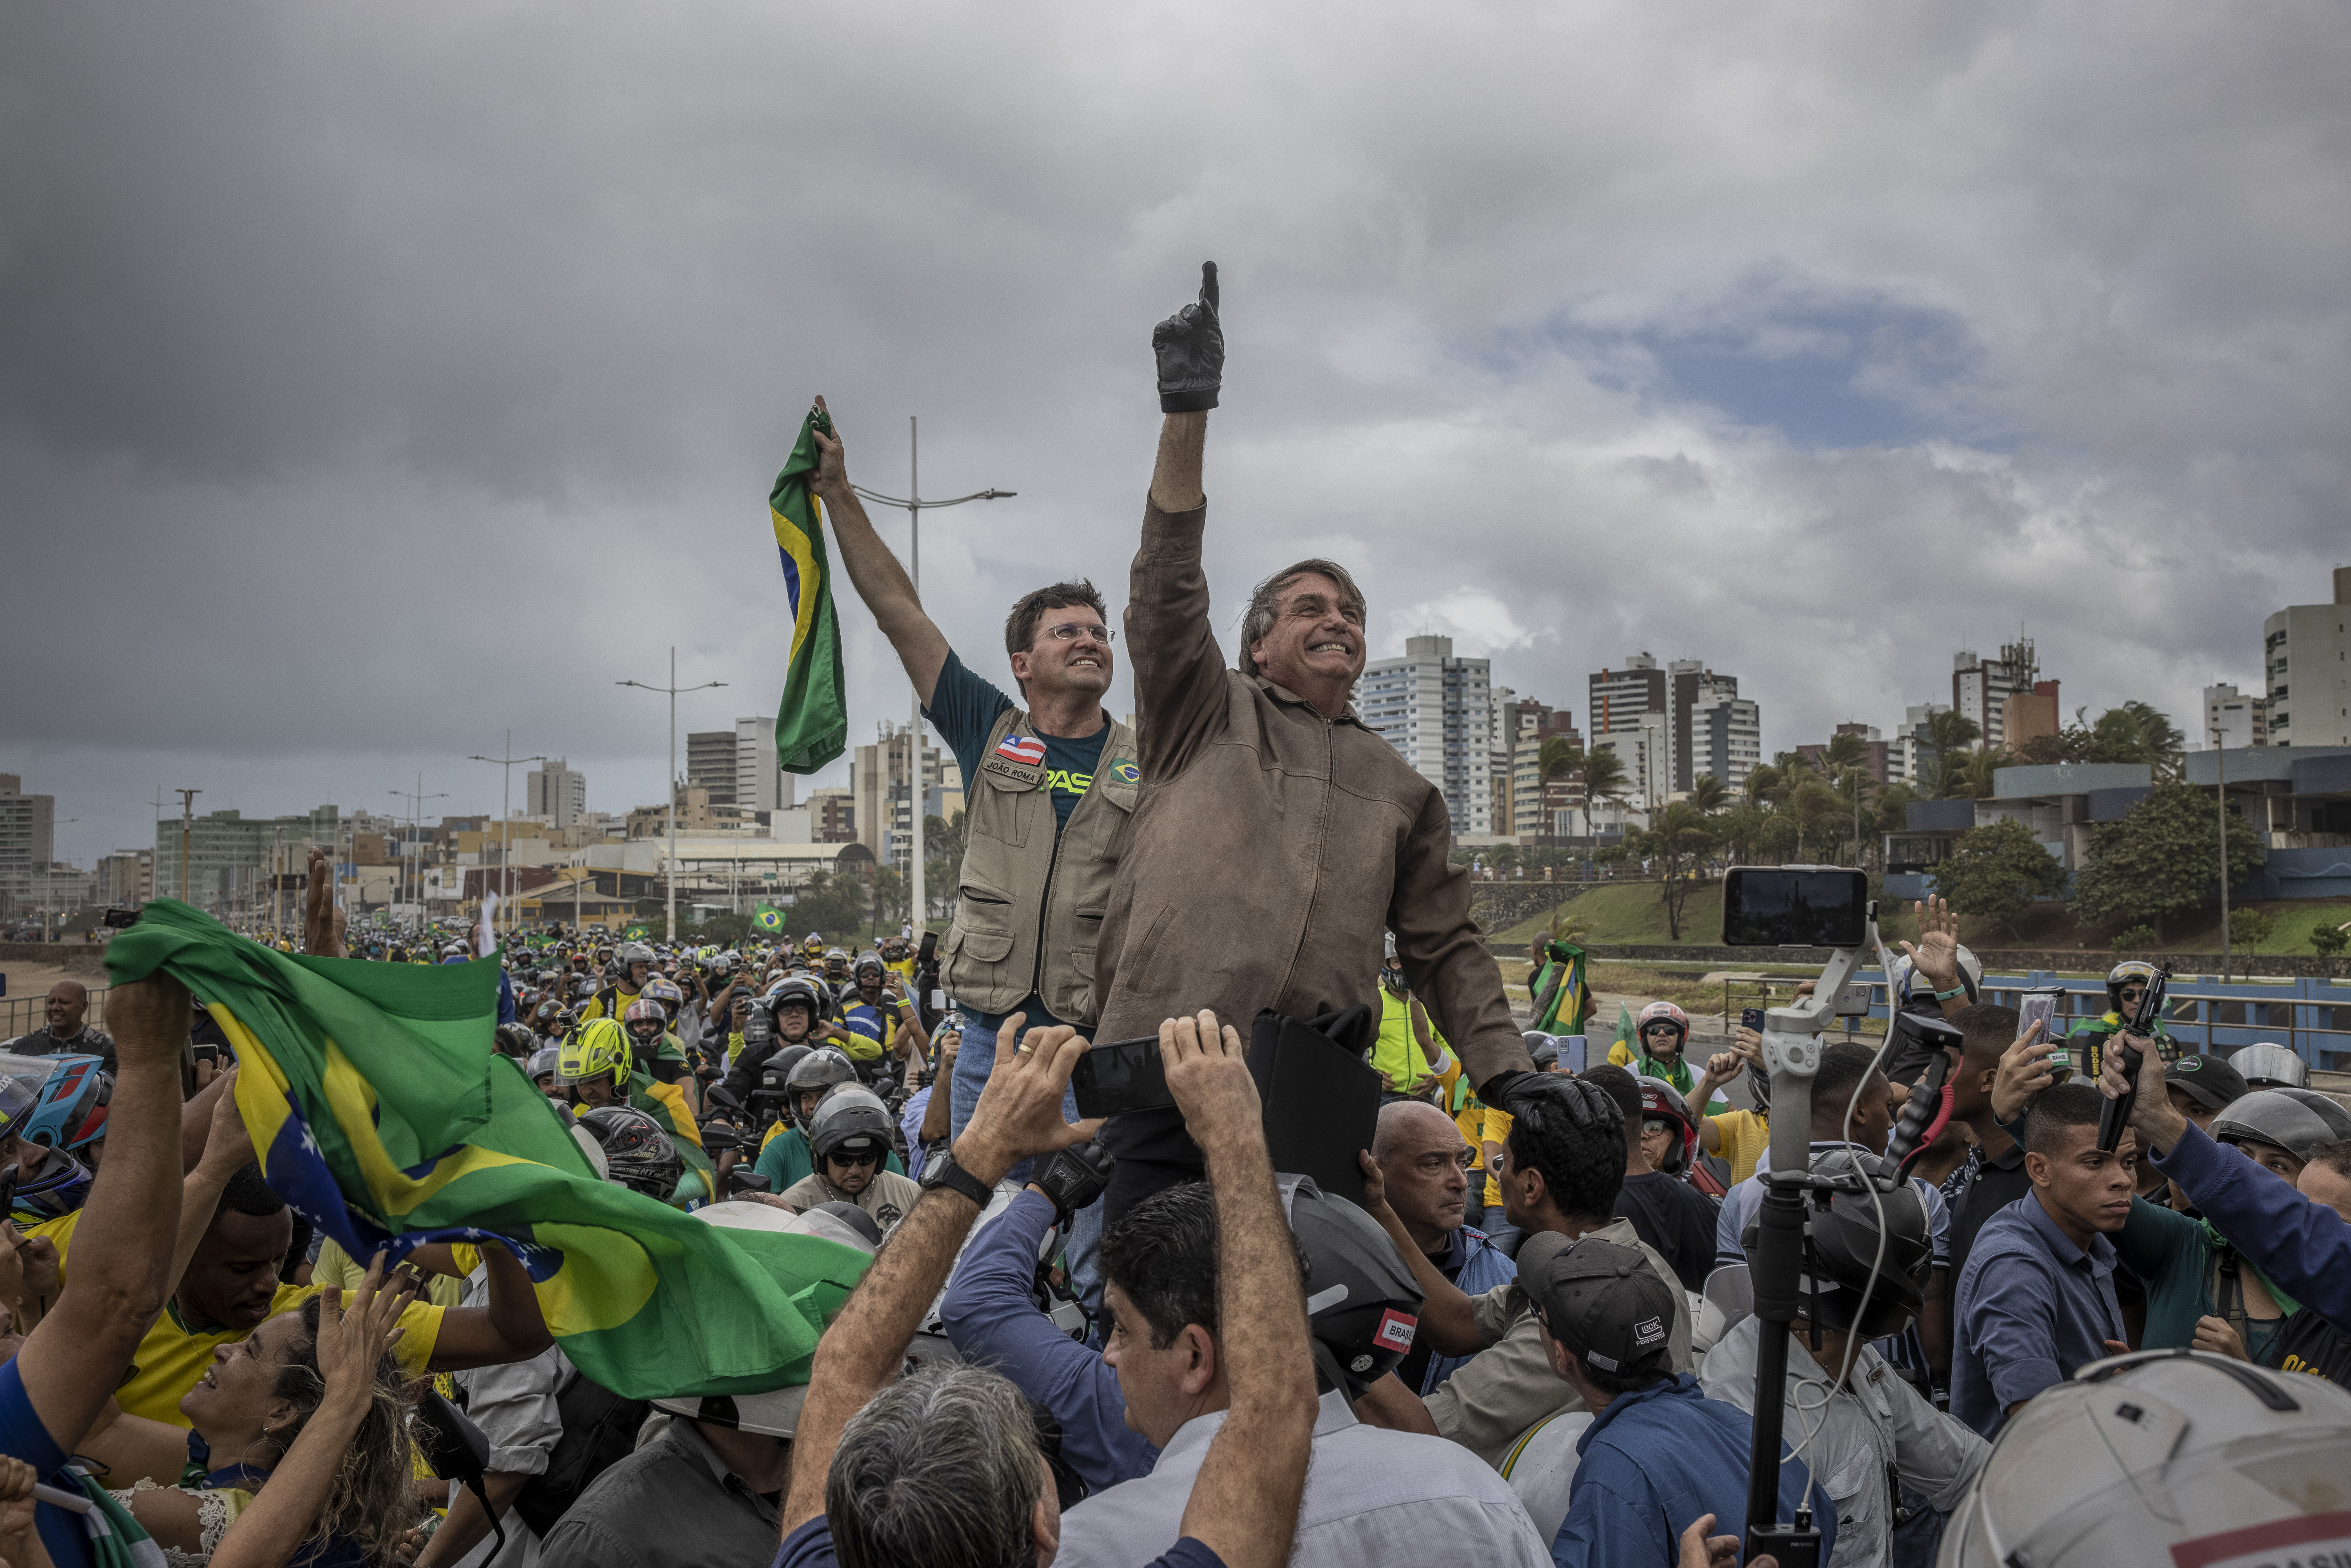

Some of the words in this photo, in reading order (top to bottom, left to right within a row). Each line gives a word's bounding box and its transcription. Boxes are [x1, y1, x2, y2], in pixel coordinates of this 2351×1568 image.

[987, 761, 1010, 774] JOÃO
[1011, 769, 1035, 782] ROMA
[2091, 1046, 2100, 1075] BODES
[640, 1168, 656, 1176] MT
[654, 1173, 676, 1182] HELMETS
[1389, 1325, 1412, 1341] BRASIL
